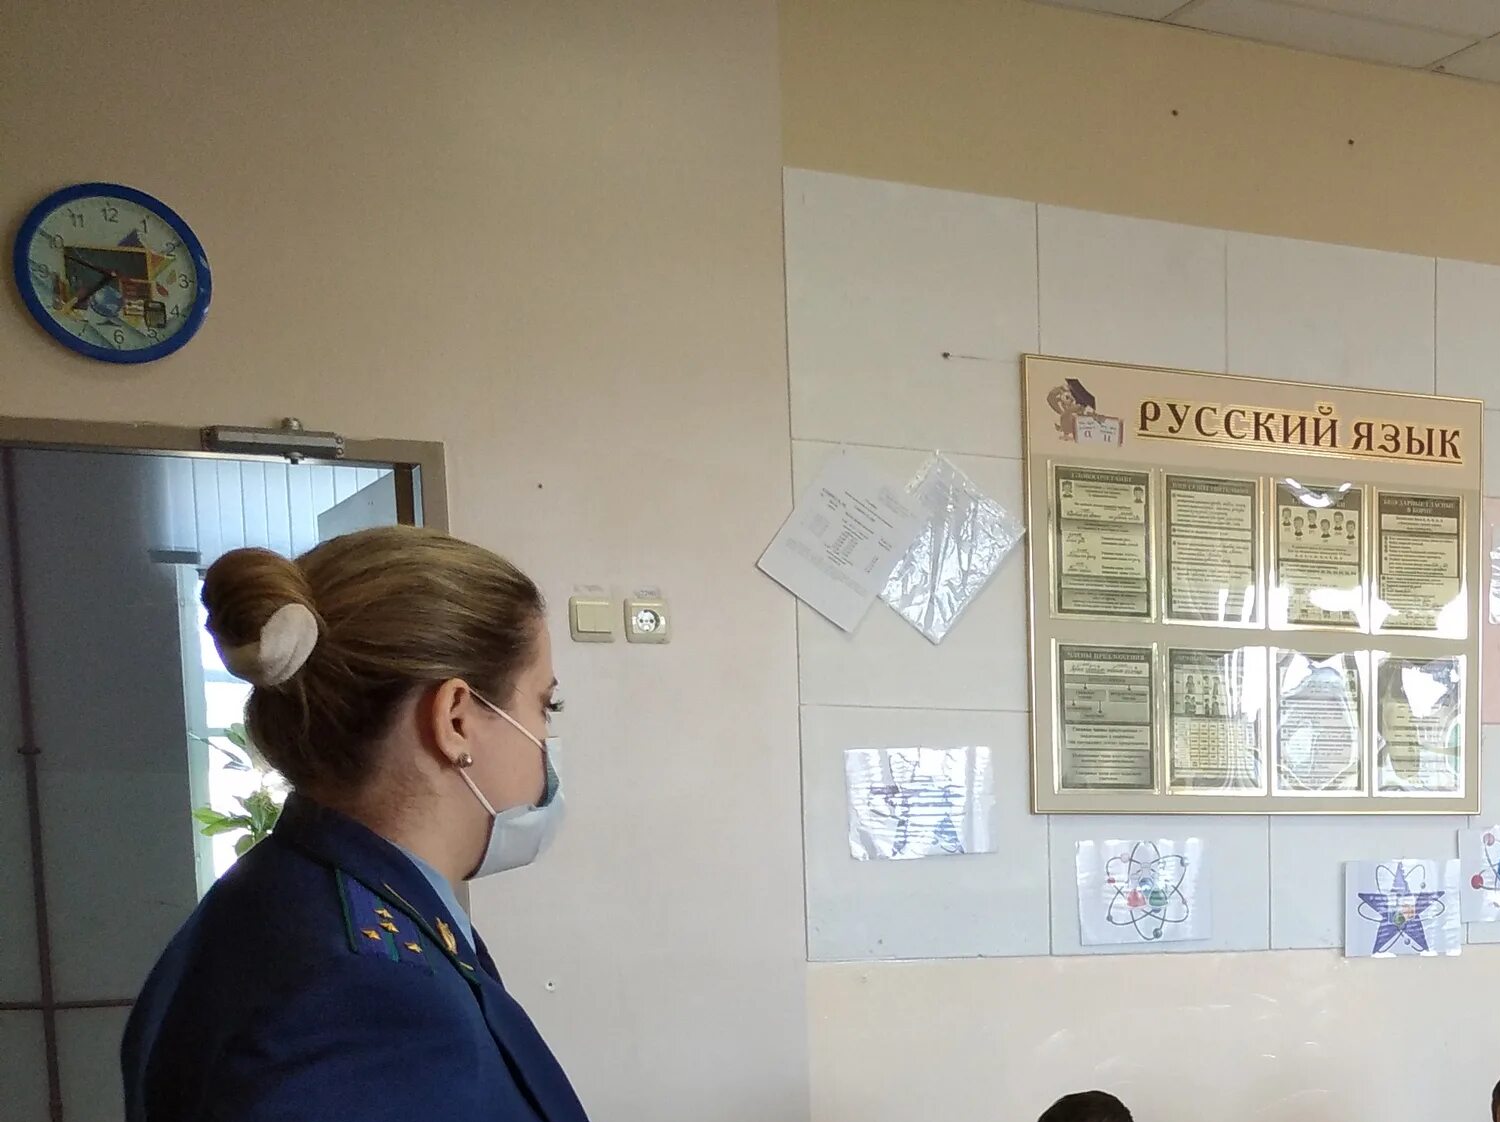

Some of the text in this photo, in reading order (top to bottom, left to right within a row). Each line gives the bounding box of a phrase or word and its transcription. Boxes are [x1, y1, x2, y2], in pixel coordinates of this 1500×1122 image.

[69, 213, 85, 229] 11
[101, 206, 119, 224] 12
[140, 219, 149, 234] 1
[47, 234, 65, 249] 10
[165, 241, 176, 257] 2
[37, 263, 50, 279] 9
[178, 274, 190, 289] 3
[169, 304, 181, 317] 4
[113, 329, 125, 345] 6
[1138, 400, 1464, 460] РУССКИЙ ЯЗЫК
